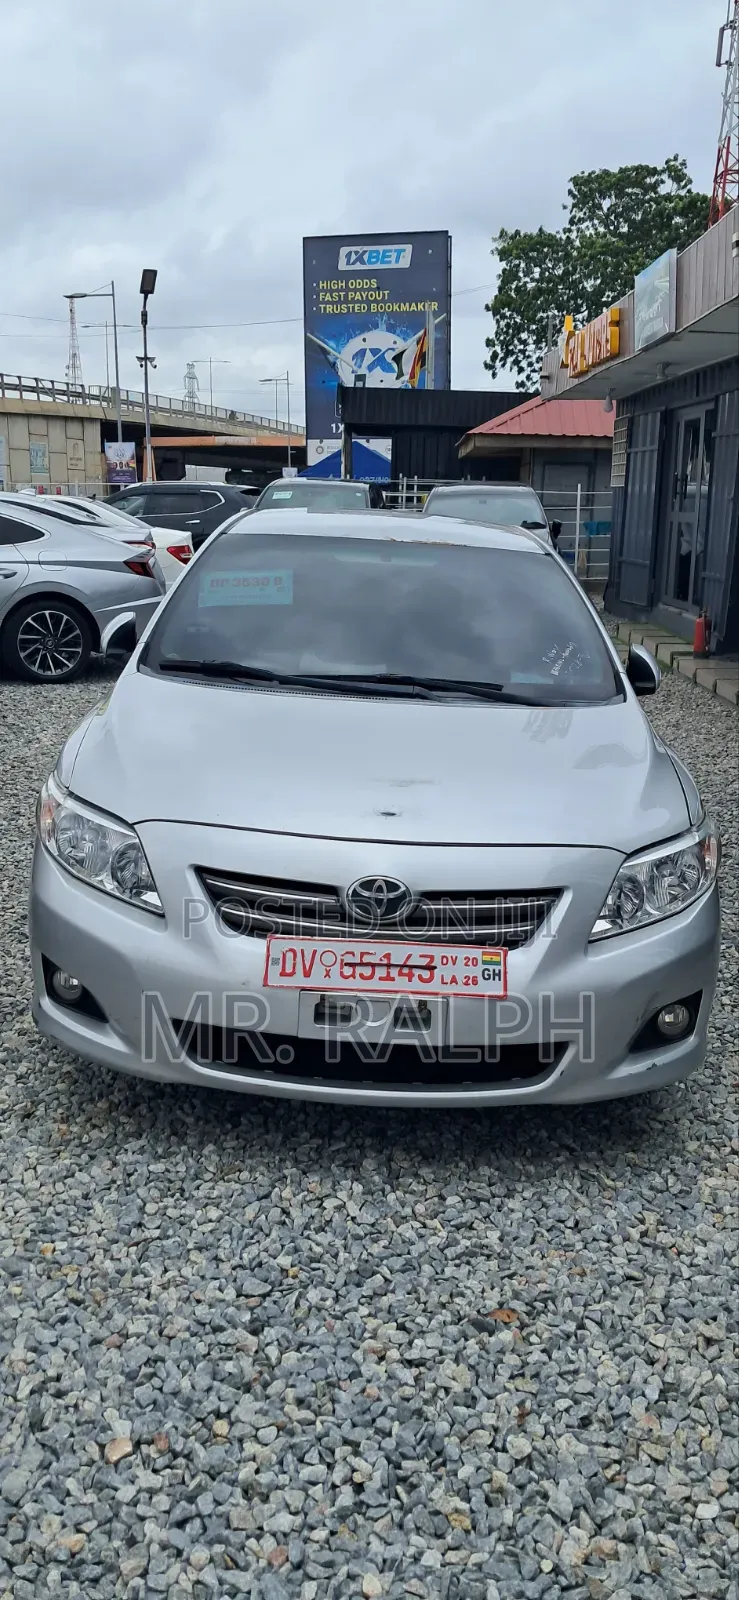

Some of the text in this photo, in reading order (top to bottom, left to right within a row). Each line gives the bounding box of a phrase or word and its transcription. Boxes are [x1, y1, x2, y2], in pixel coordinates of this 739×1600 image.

[344, 248, 406, 266] 1XBET
[319, 279, 377, 290] HIGH ODDS
[319, 290, 390, 302] FAST PAYOUT
[319, 303, 368, 314] TRUSTED
[279, 947, 317, 979] DV
[440, 955, 479, 967] DV 20
[440, 973, 479, 987] LA 26
[481, 967, 502, 982] GH
